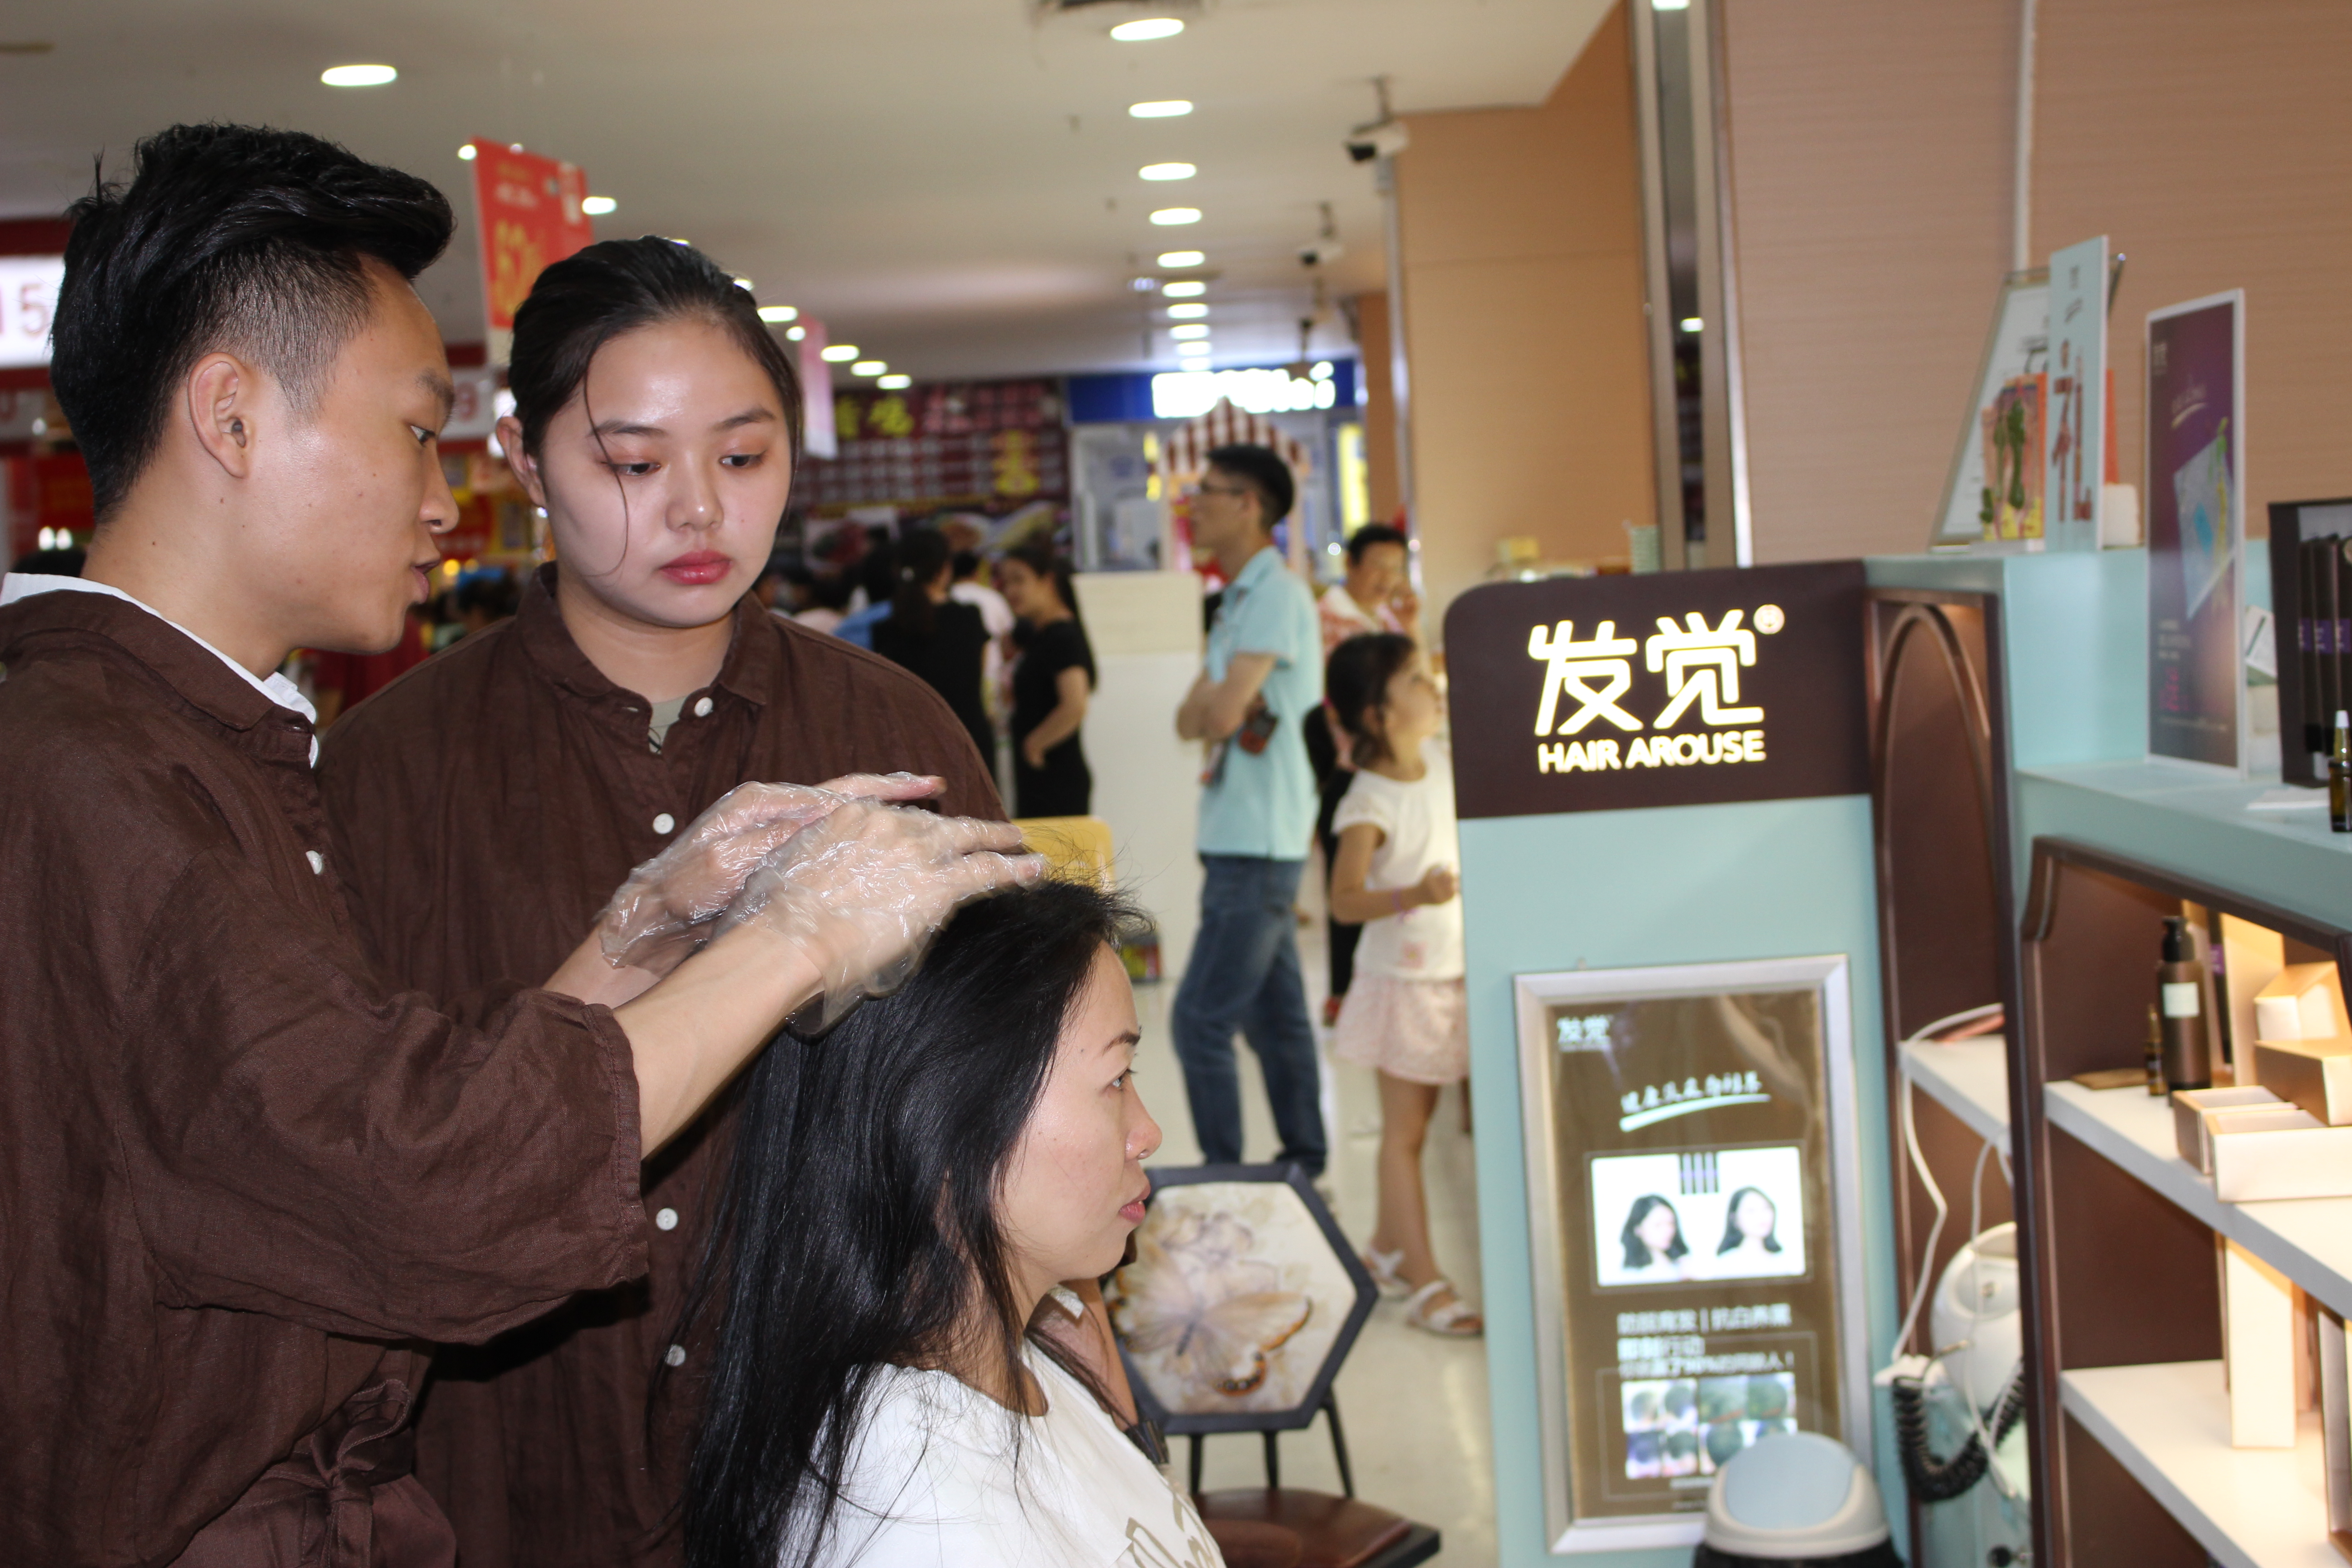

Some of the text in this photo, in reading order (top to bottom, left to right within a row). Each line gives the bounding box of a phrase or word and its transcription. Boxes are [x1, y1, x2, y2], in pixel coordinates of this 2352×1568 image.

[1528, 608, 1764, 737] 发觉
[1537, 730, 1766, 774] HAIR AROUSE
